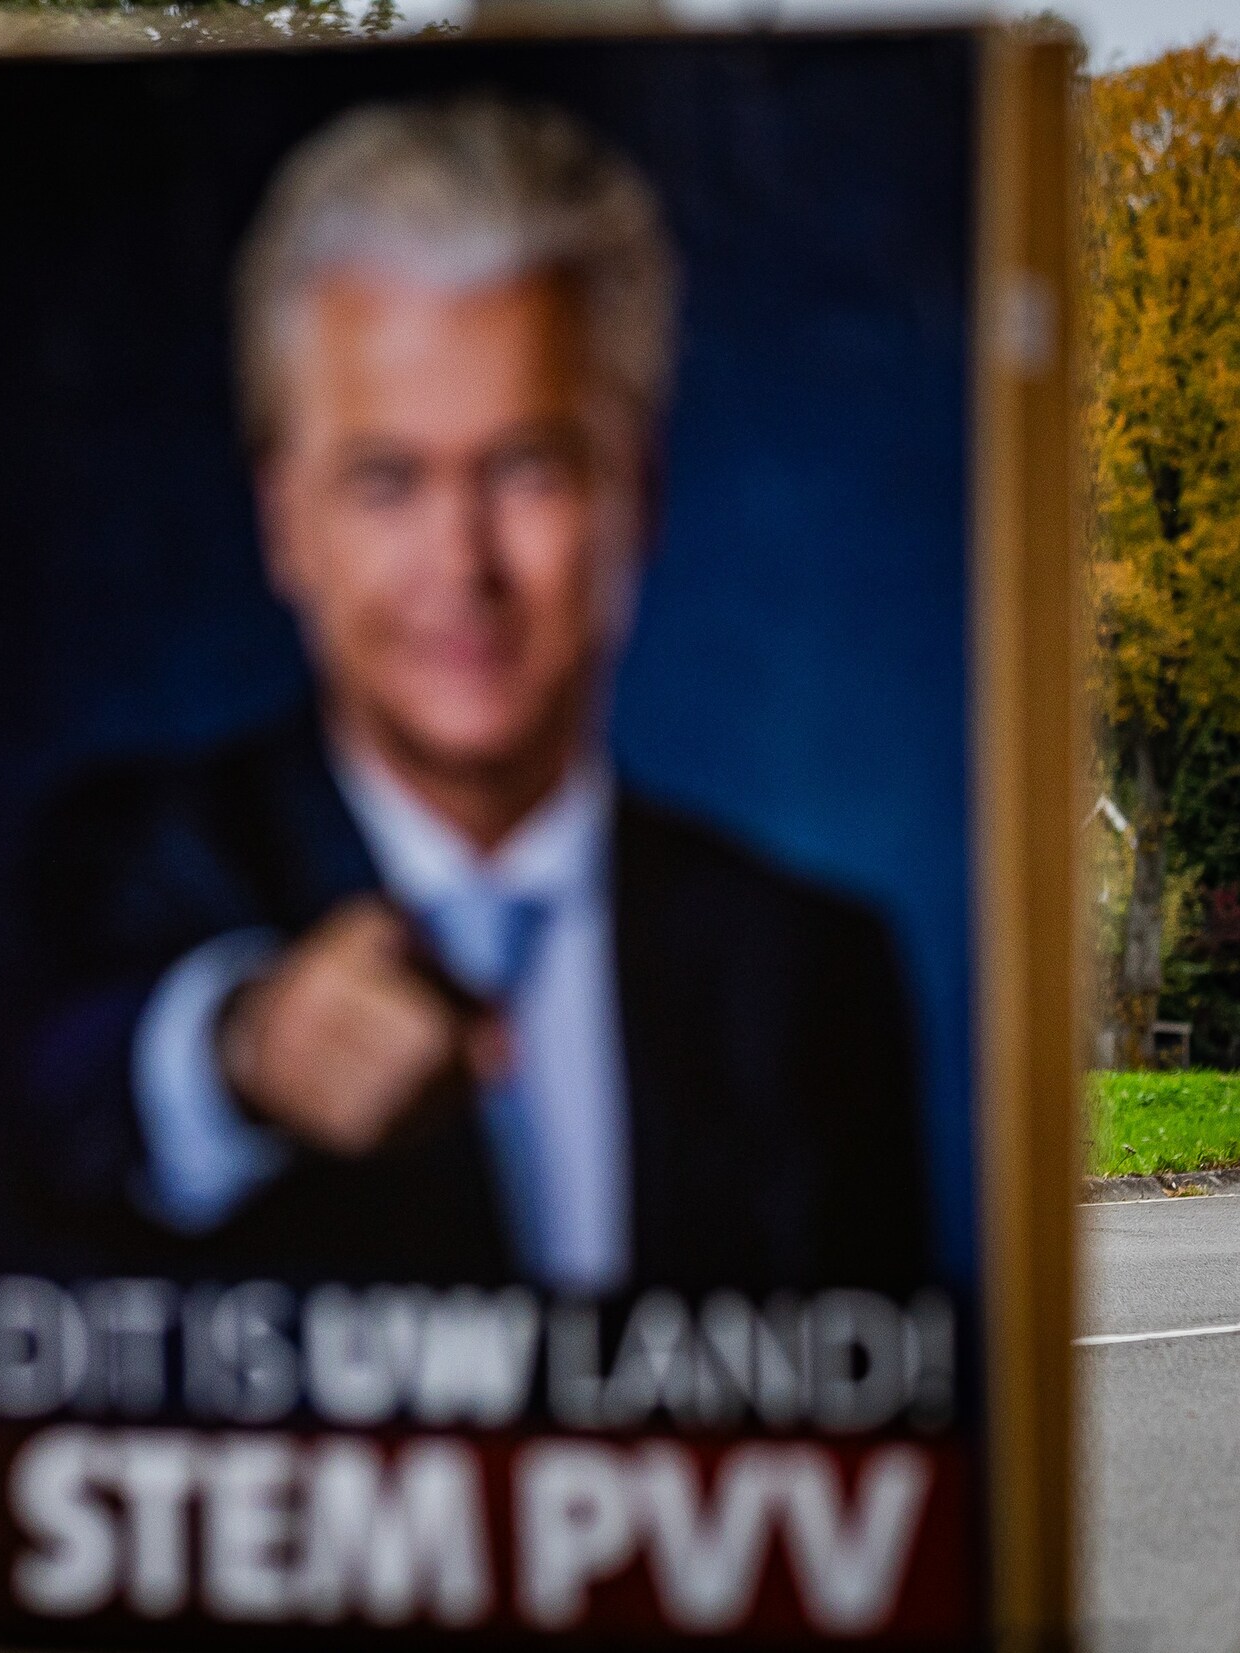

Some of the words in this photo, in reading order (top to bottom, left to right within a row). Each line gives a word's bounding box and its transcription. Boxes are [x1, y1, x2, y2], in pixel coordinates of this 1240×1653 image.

[305, 1283, 539, 1427] UW
[10, 1429, 494, 1624] STEM
[514, 1434, 932, 1632] PVV
